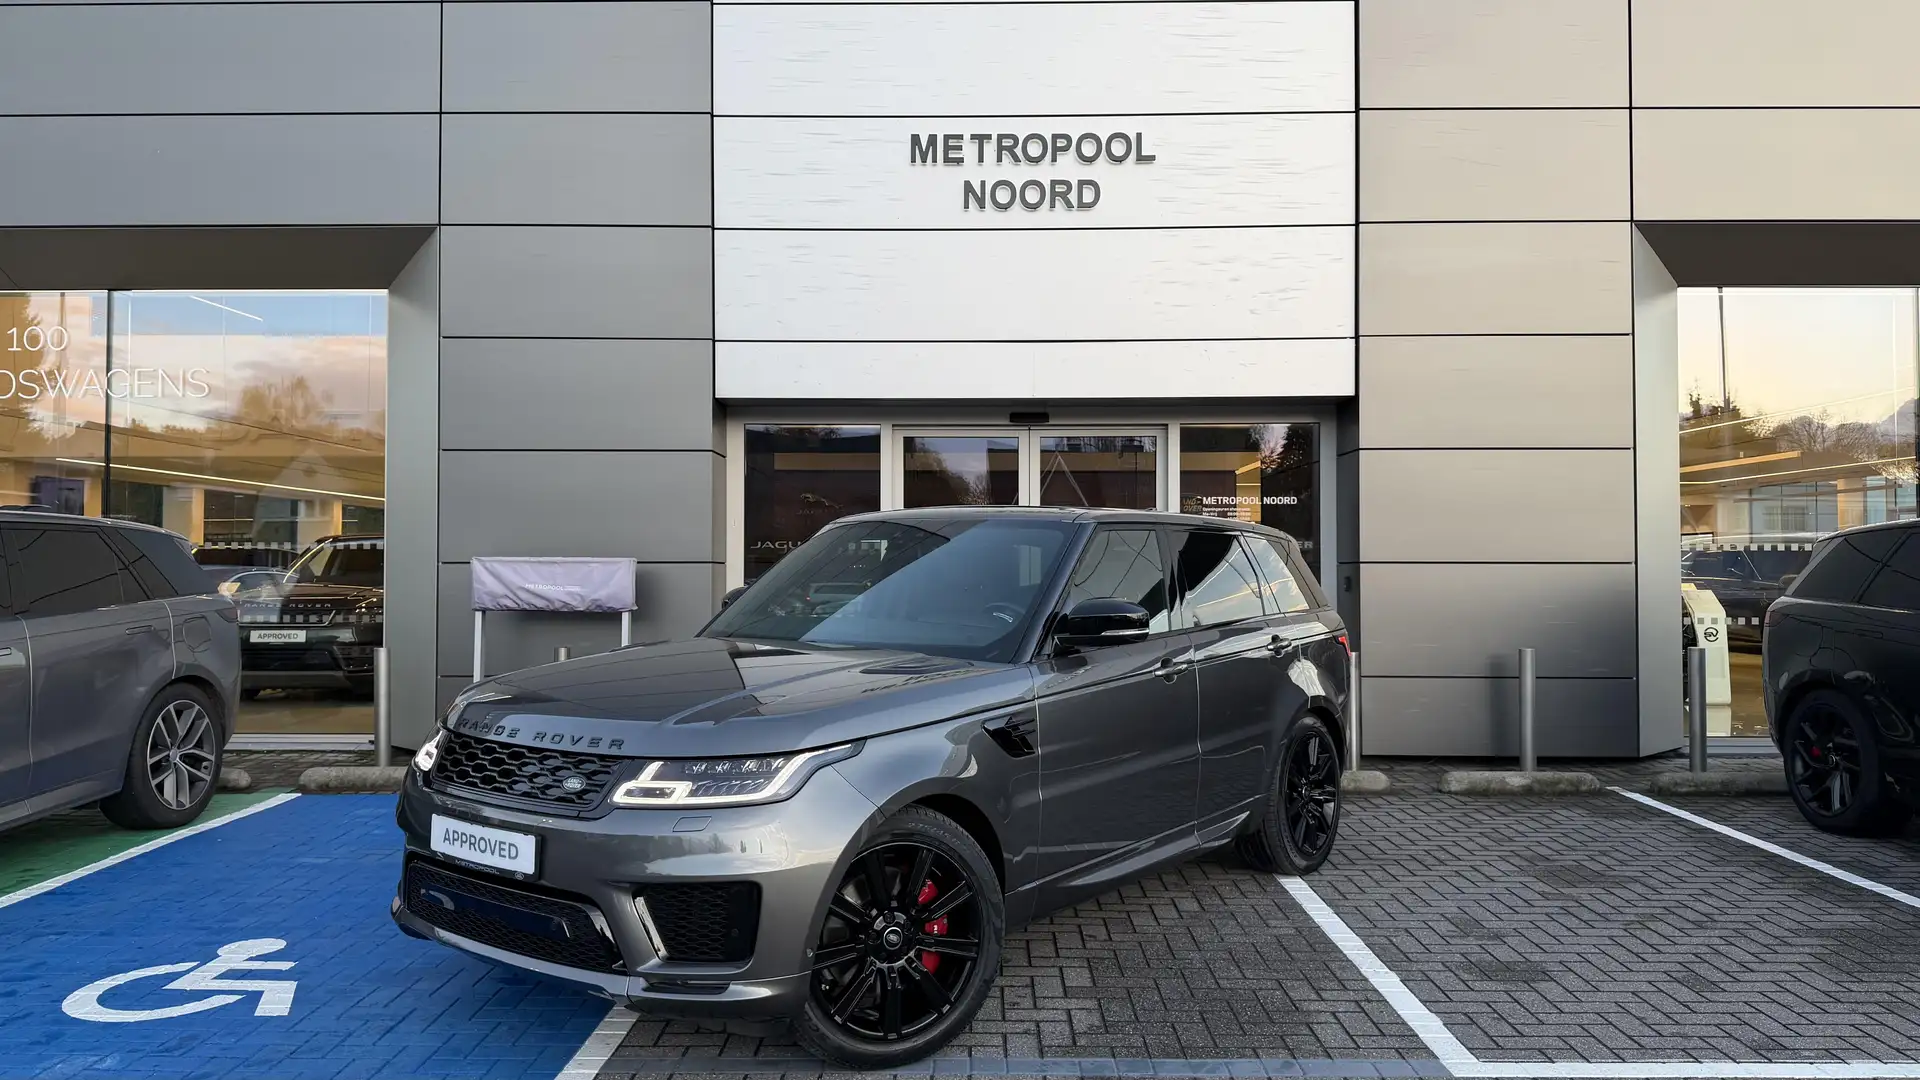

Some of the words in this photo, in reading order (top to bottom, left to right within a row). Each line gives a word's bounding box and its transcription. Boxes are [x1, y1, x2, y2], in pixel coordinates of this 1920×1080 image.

[910, 132, 1156, 164] METROPOOL
[963, 179, 1101, 210] NOORD
[6, 325, 68, 351] 100
[1202, 496, 1261, 505] METROPOOL
[1263, 496, 1298, 505] NOORD
[257, 632, 299, 640] APPROVED
[458, 718, 521, 738] RANGE
[532, 731, 625, 750] ROVER
[443, 827, 519, 860] APPROVED
